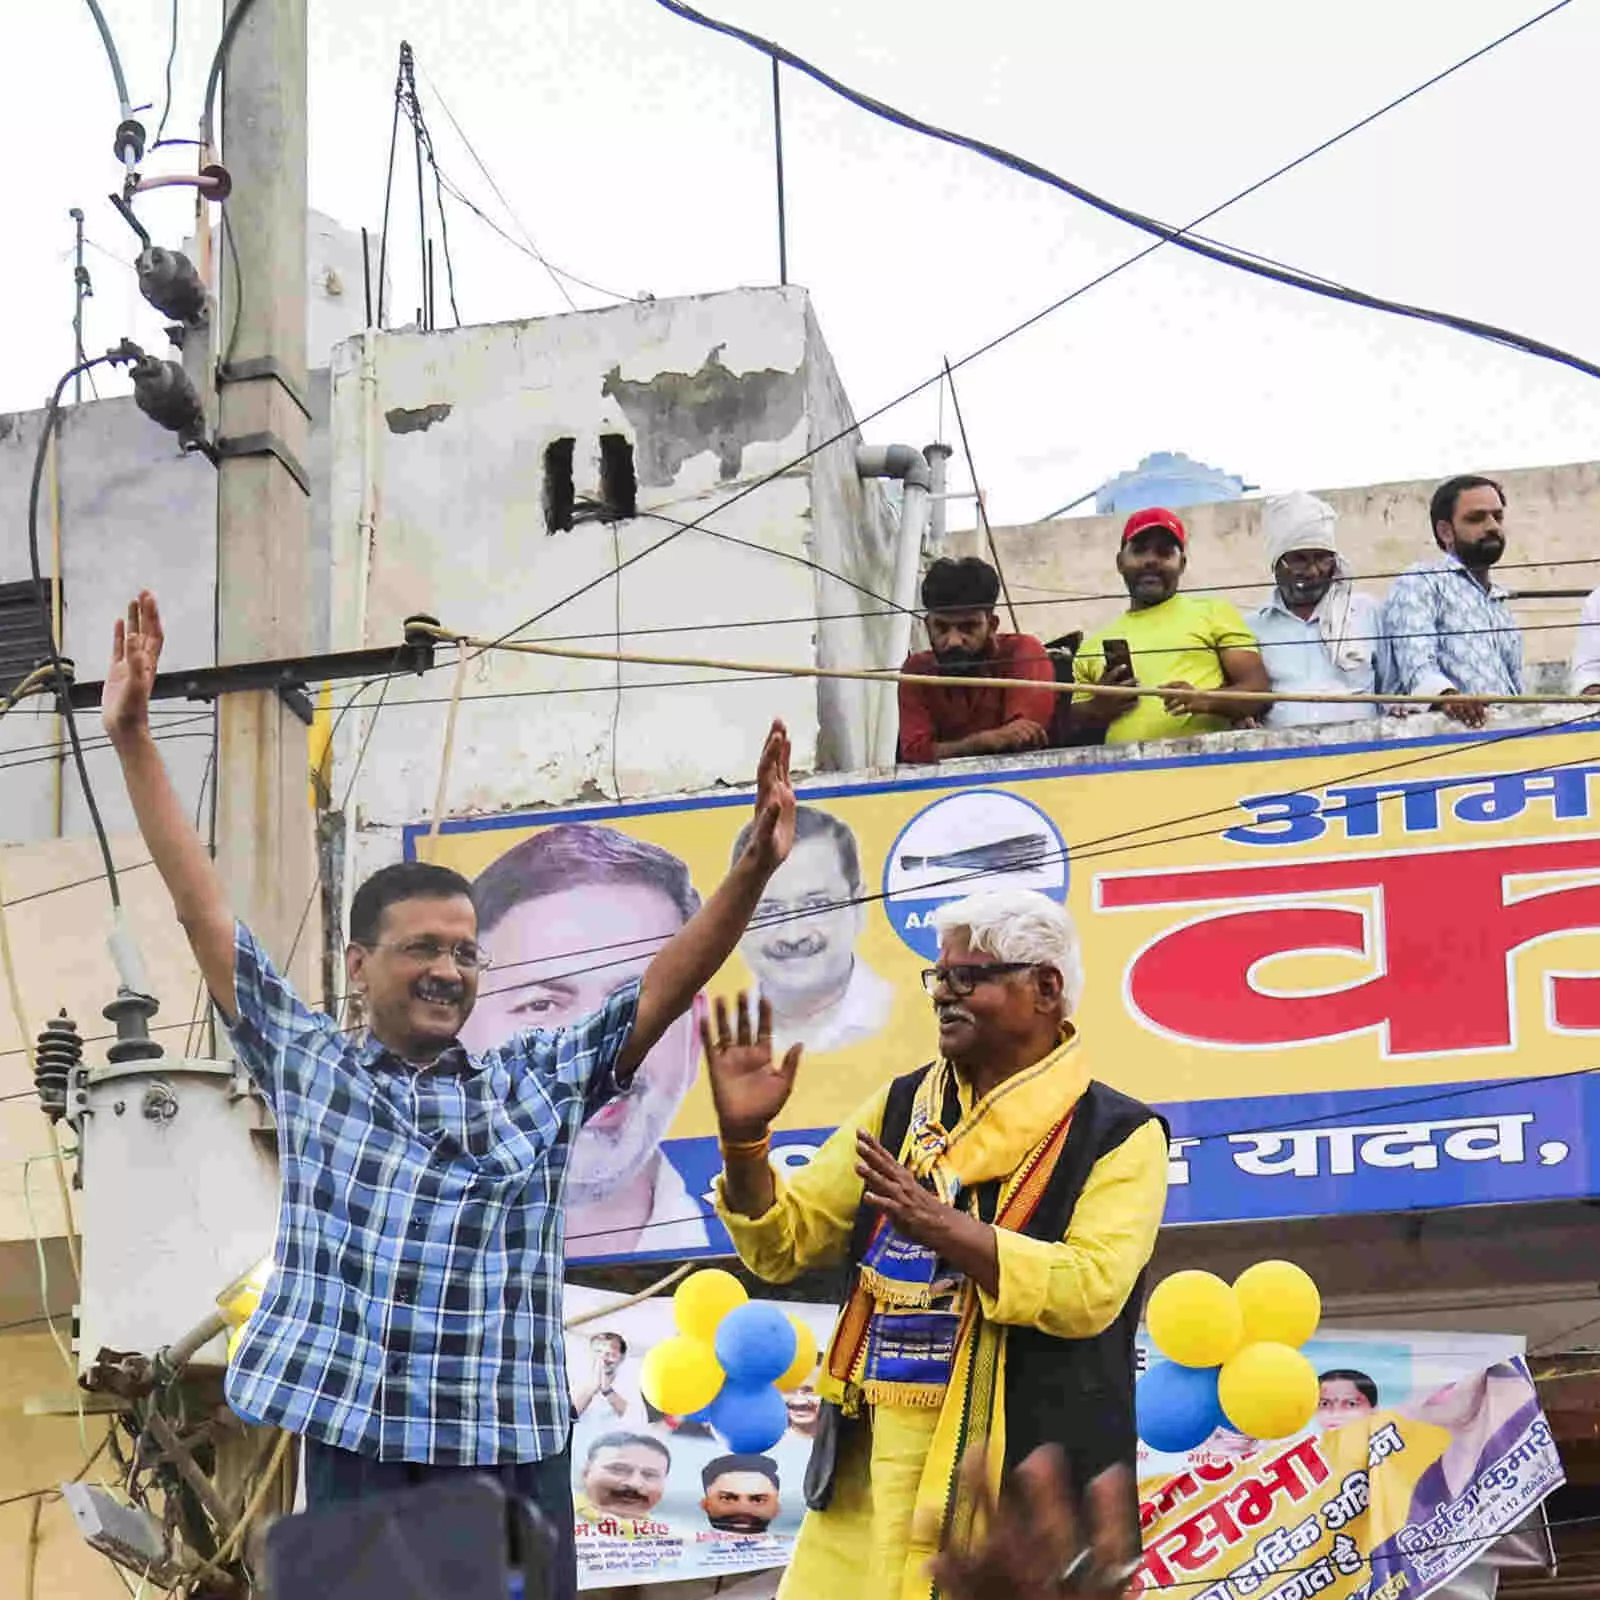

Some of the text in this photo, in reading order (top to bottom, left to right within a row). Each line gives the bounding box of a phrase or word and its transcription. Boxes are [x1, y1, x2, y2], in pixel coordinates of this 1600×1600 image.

[1221, 764, 1600, 849] आम
[1227, 1111, 1570, 1180] यादव,
[1228, 1513, 1322, 1595] हार्दिक
